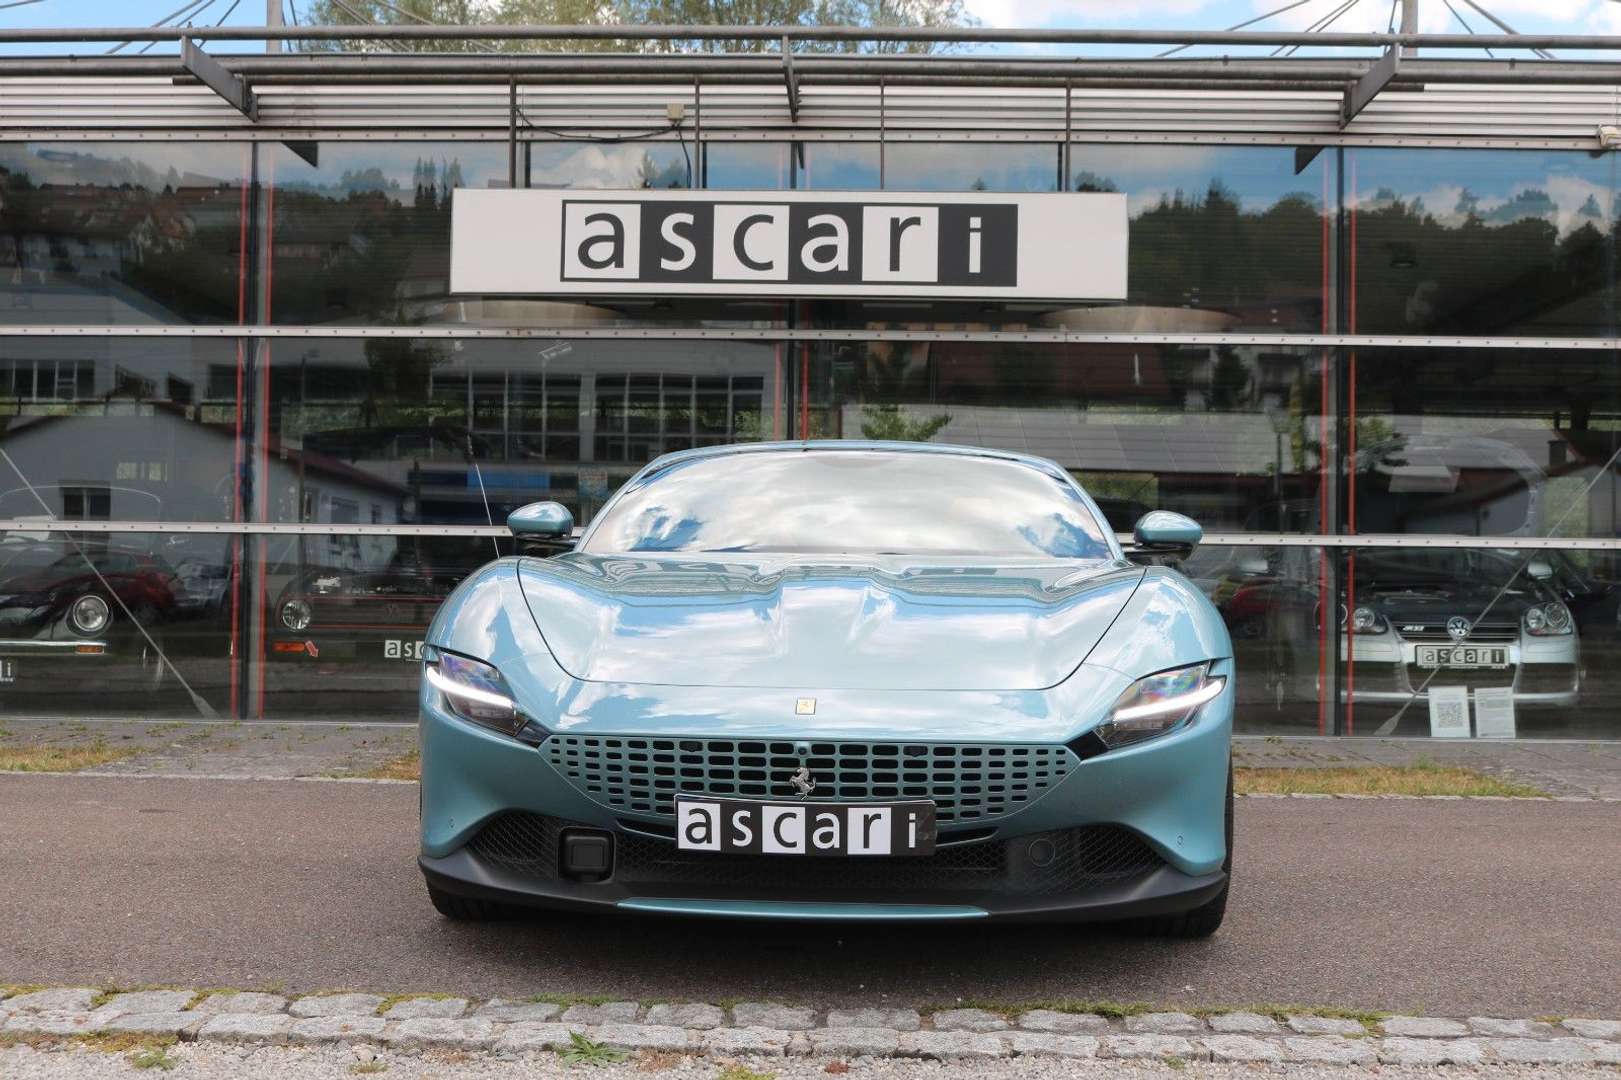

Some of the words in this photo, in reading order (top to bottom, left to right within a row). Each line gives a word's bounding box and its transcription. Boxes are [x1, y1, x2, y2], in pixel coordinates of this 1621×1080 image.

[577, 212, 982, 274] ascari
[1424, 649, 1500, 662] ascari
[685, 807, 917, 849] ascari
